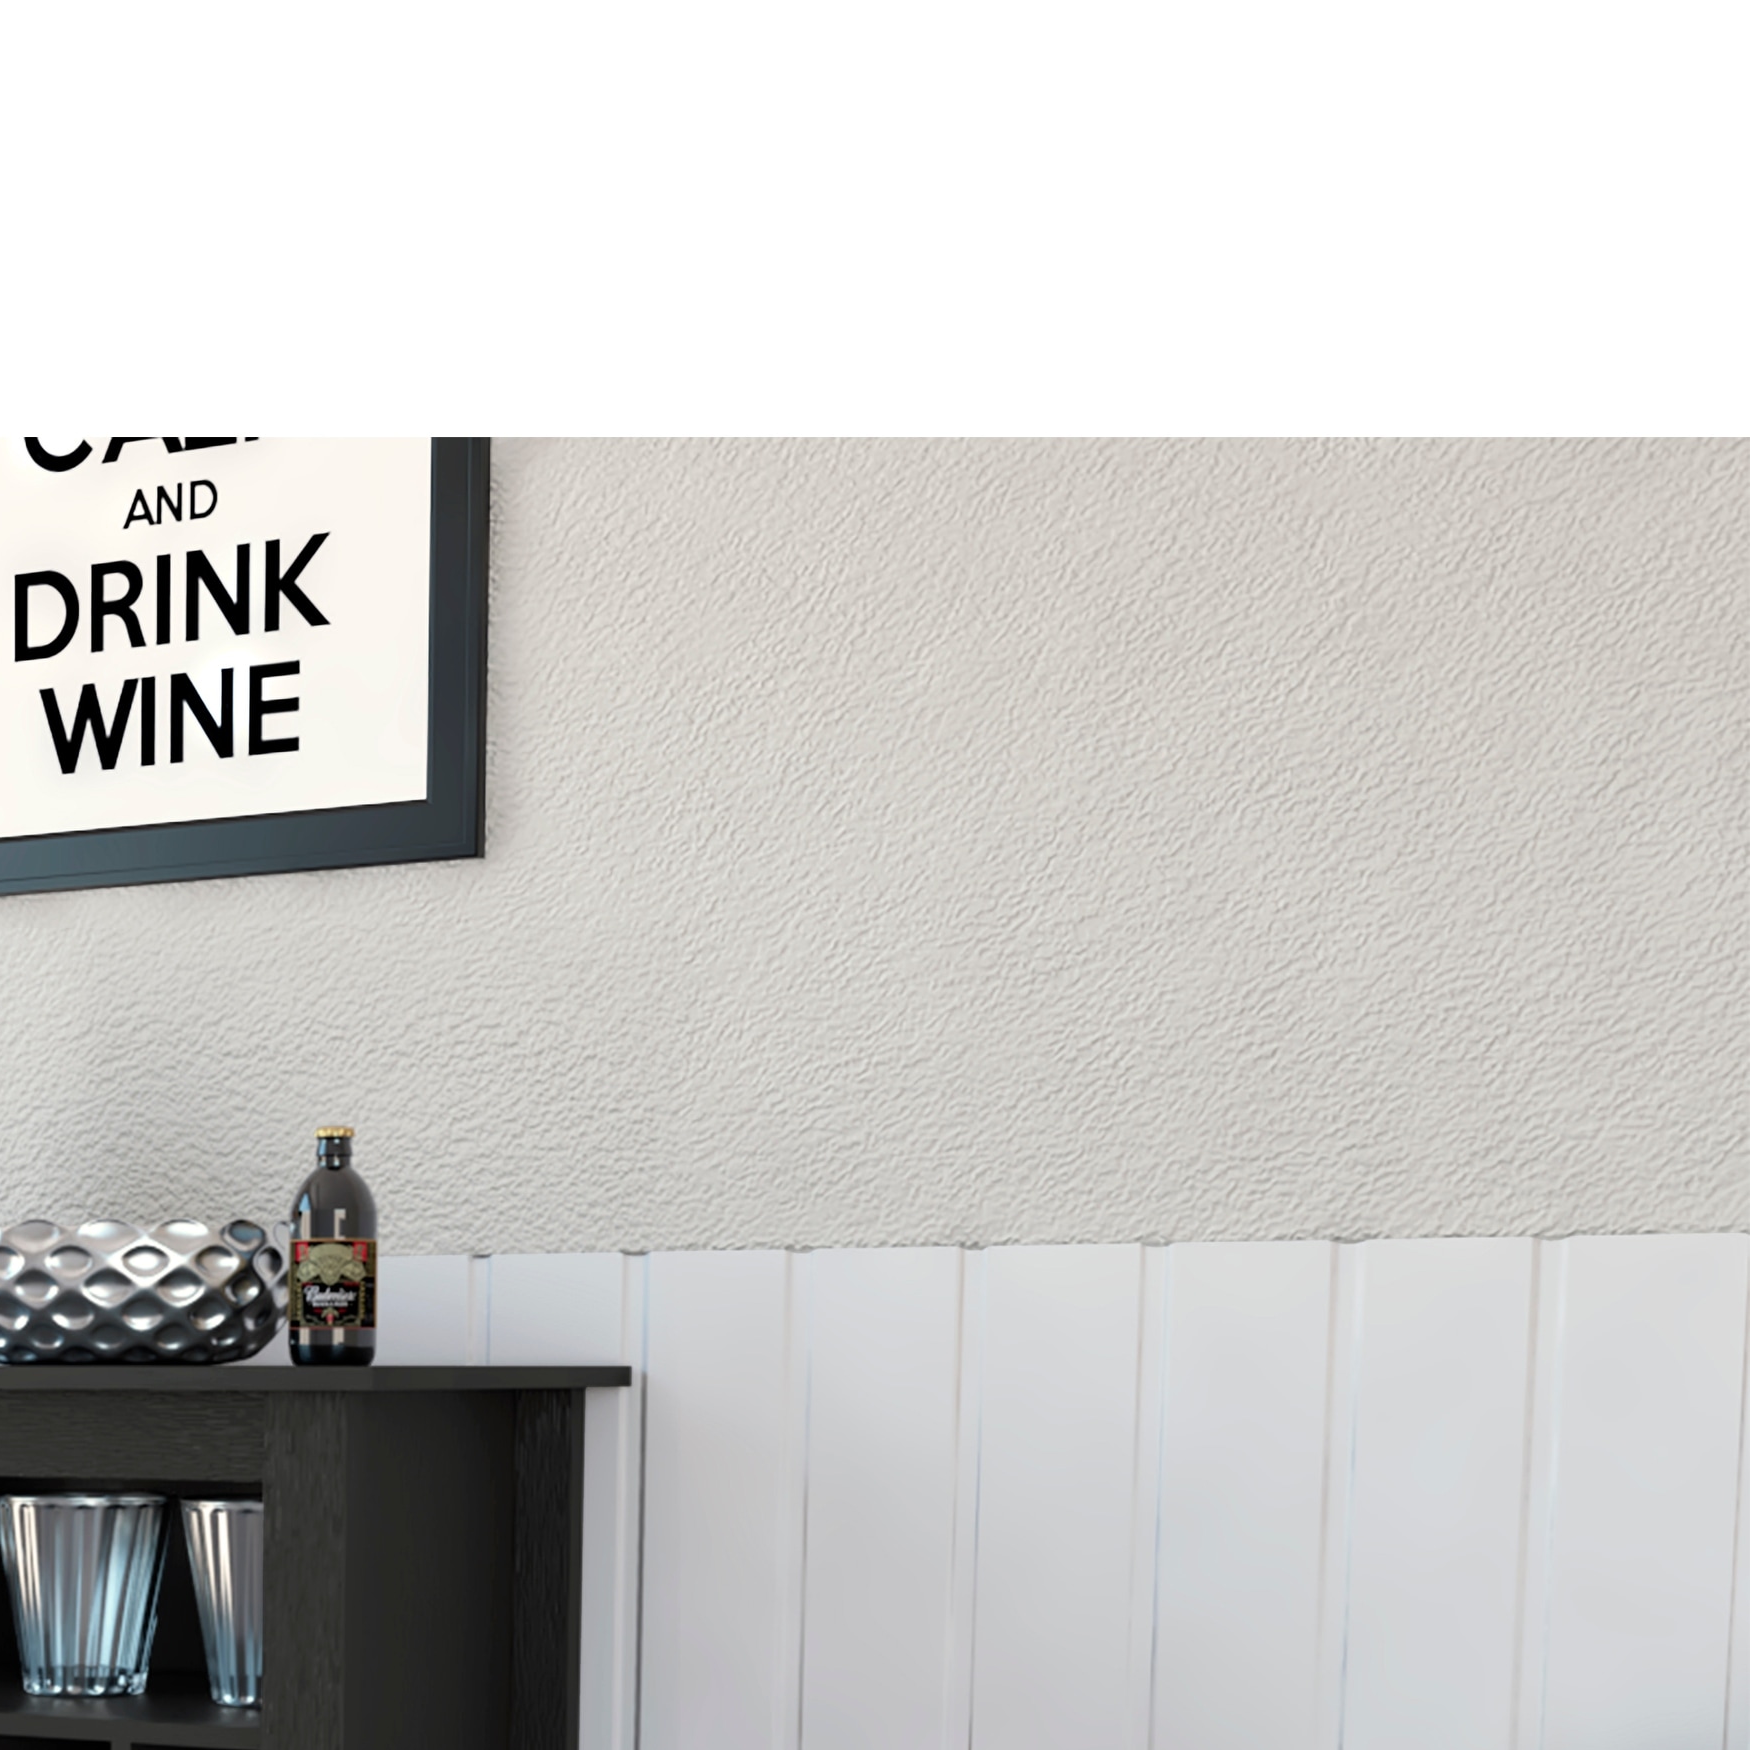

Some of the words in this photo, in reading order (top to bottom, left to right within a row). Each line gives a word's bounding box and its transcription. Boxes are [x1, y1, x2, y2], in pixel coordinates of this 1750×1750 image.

[122, 479, 218, 530] AND
[14, 531, 332, 663] DRINK
[39, 660, 301, 775] WINE
